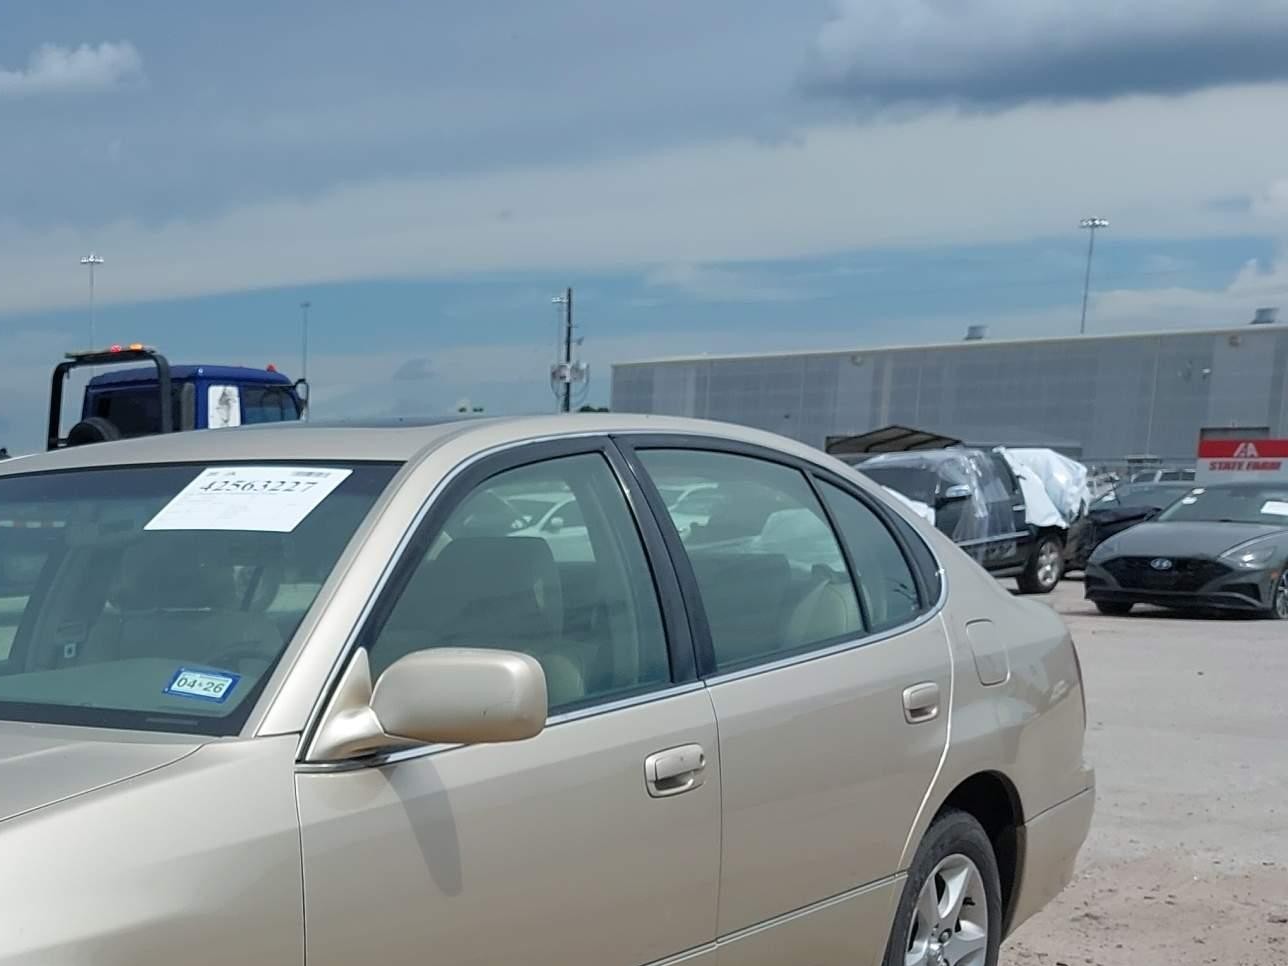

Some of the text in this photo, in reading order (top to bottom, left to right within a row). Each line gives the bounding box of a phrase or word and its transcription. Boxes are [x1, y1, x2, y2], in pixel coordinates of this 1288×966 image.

[199, 480, 319, 493] 42563227
[177, 677, 198, 689] 04
[203, 681, 225, 694] 26
